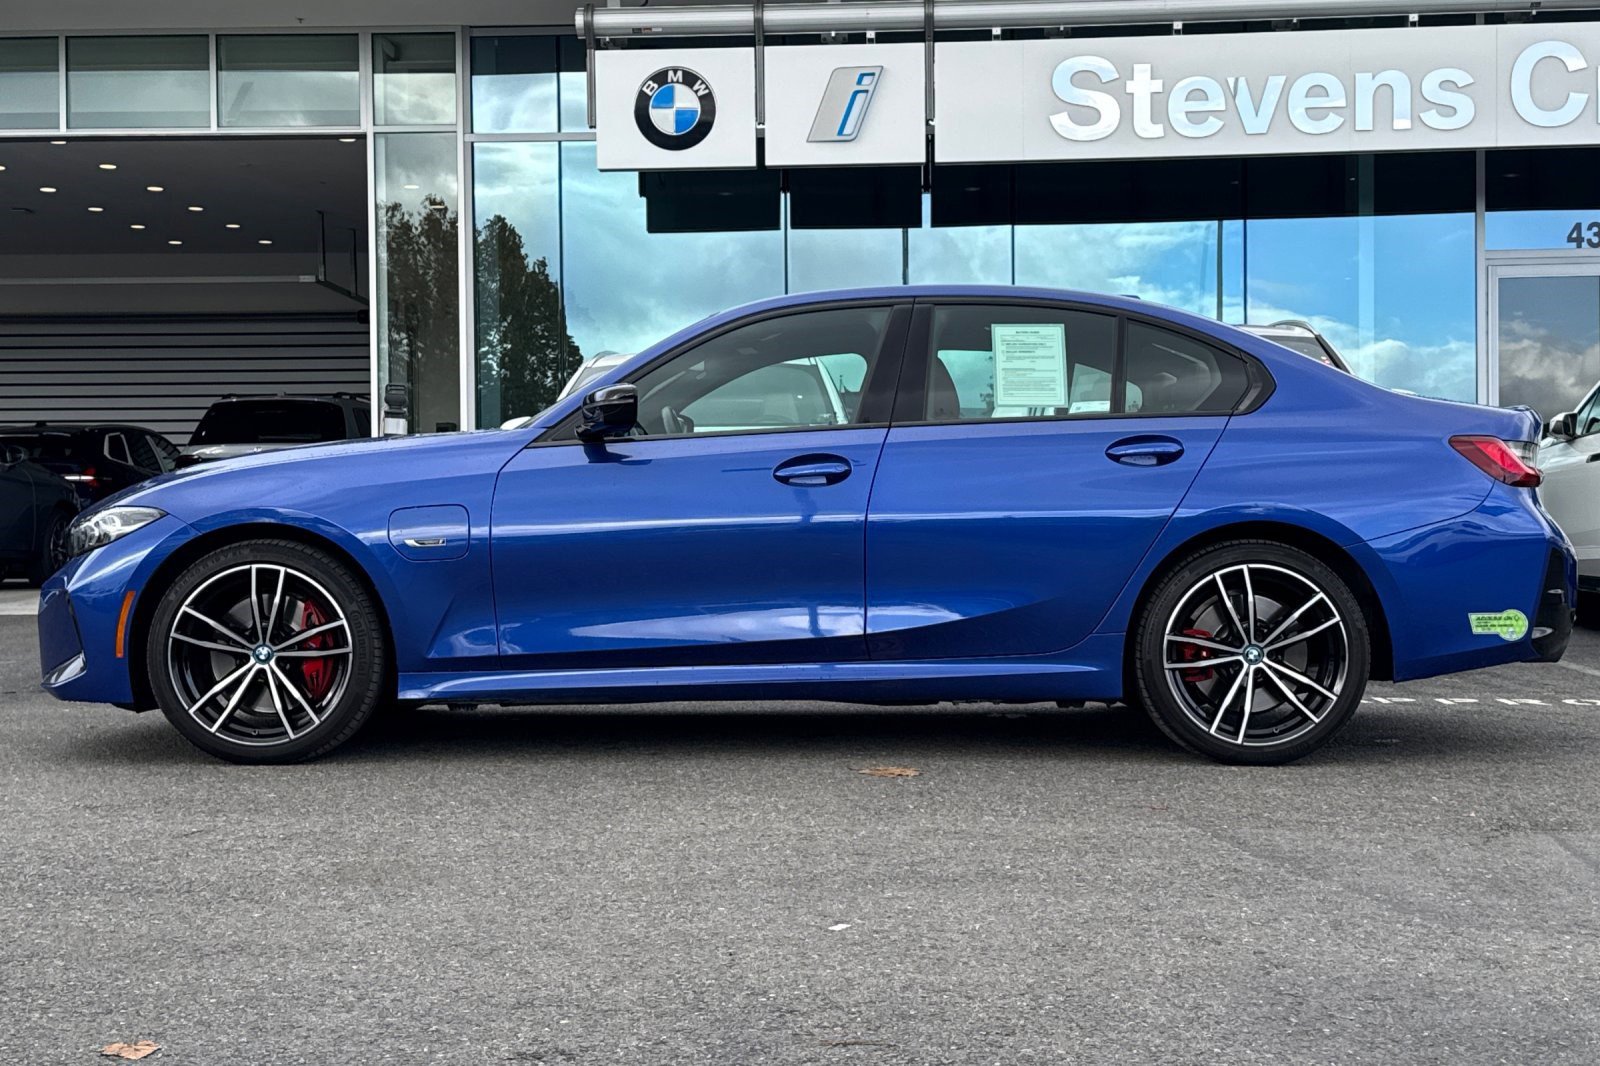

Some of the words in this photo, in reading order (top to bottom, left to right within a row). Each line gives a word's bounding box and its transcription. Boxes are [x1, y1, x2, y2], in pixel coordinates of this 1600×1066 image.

[642, 69, 710, 97] BMW
[1048, 54, 1475, 142] Stevens
[1509, 40, 1600, 128] C
[837, 72, 876, 137] i
[1566, 221, 1600, 249] 43
[1360, 696, 1600, 706] PPRO
